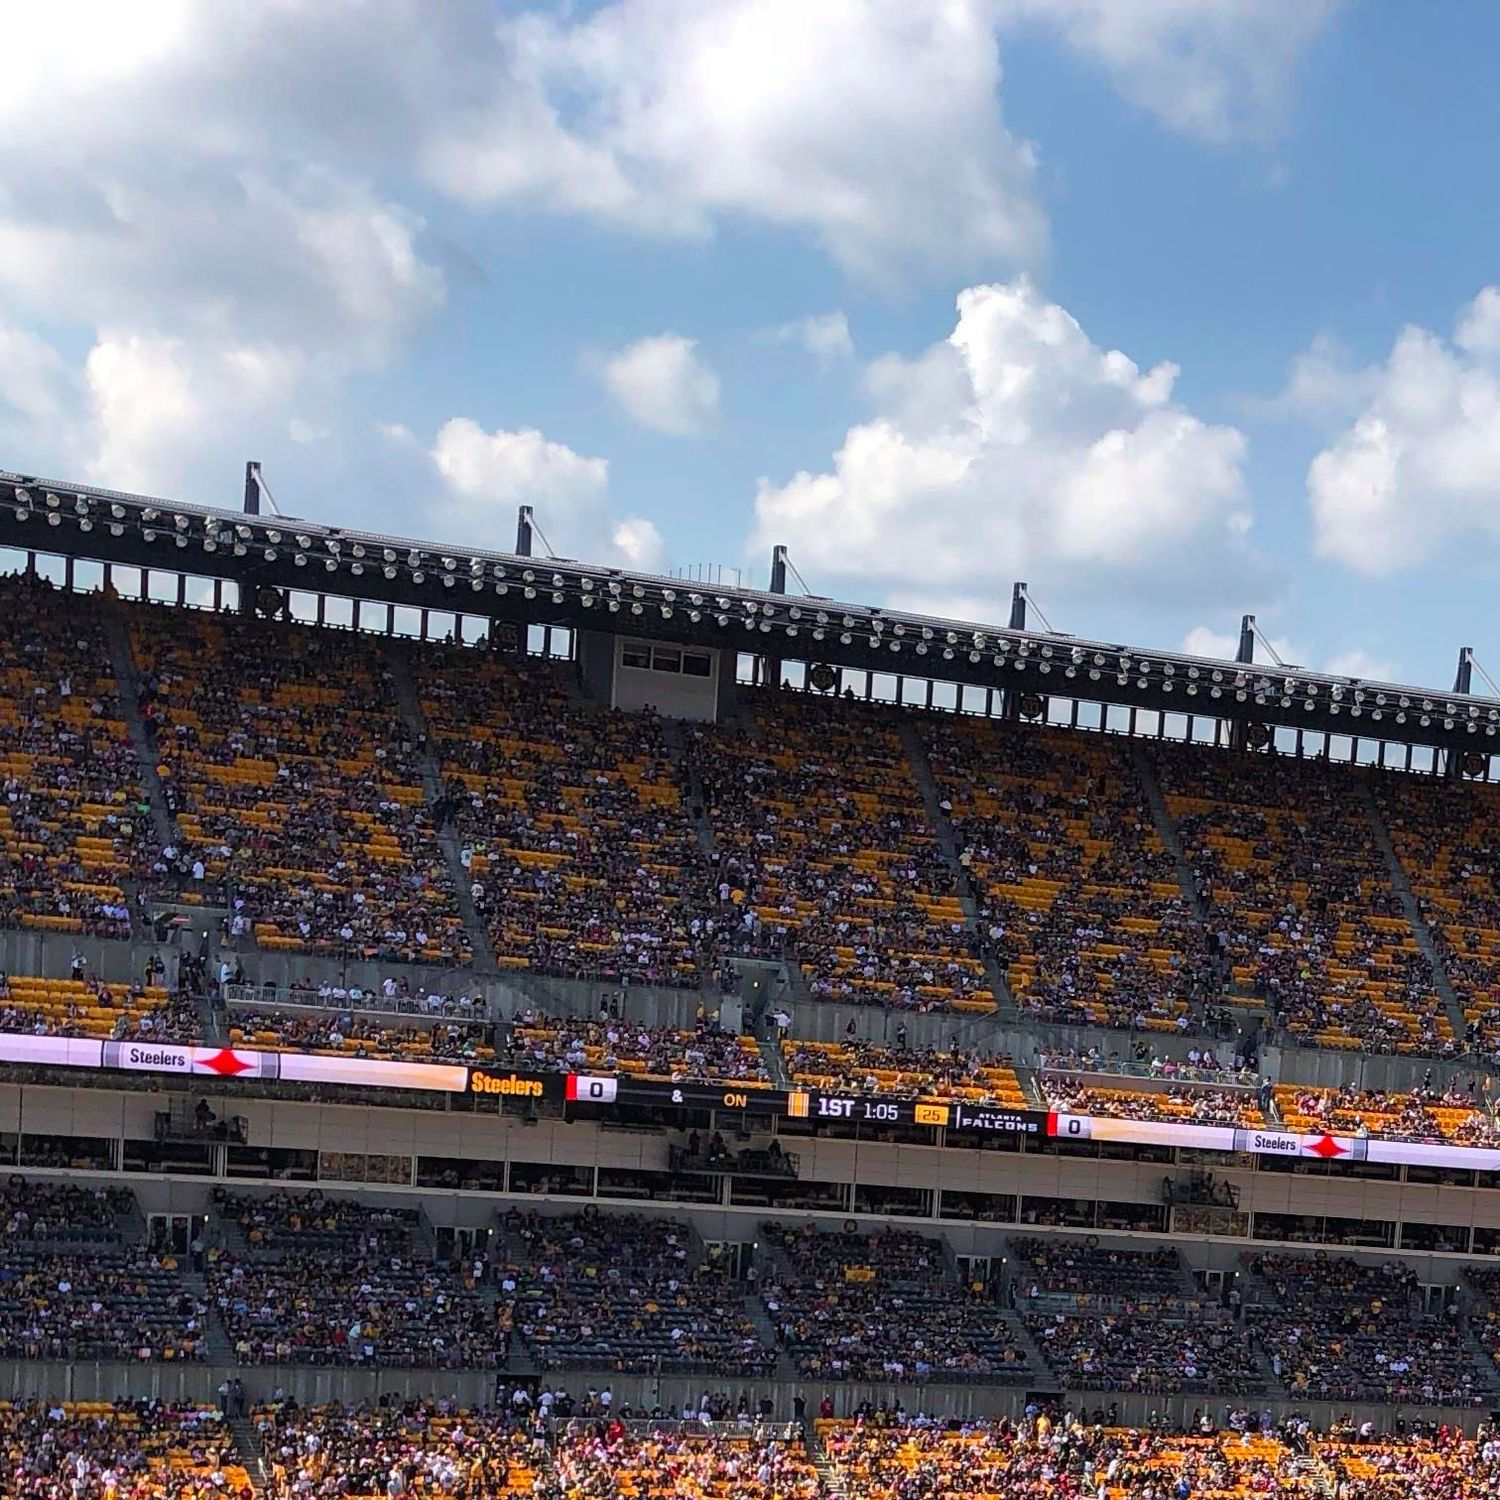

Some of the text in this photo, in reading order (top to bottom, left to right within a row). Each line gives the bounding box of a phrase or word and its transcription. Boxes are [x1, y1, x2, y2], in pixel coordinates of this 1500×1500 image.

[129, 1048, 186, 1068] Steelers
[471, 1072, 544, 1097] Steelers
[589, 1081, 602, 1098] 0
[671, 1089, 683, 1103] &
[723, 1093, 748, 1108] ON
[818, 1098, 898, 1121] 1ST 1:05
[922, 1109, 941, 1122] 25
[978, 1112, 1022, 1122] ATLANTA
[962, 1117, 1038, 1132] FALCONS
[1067, 1119, 1081, 1135] 0
[1254, 1135, 1297, 1152] Steelers
